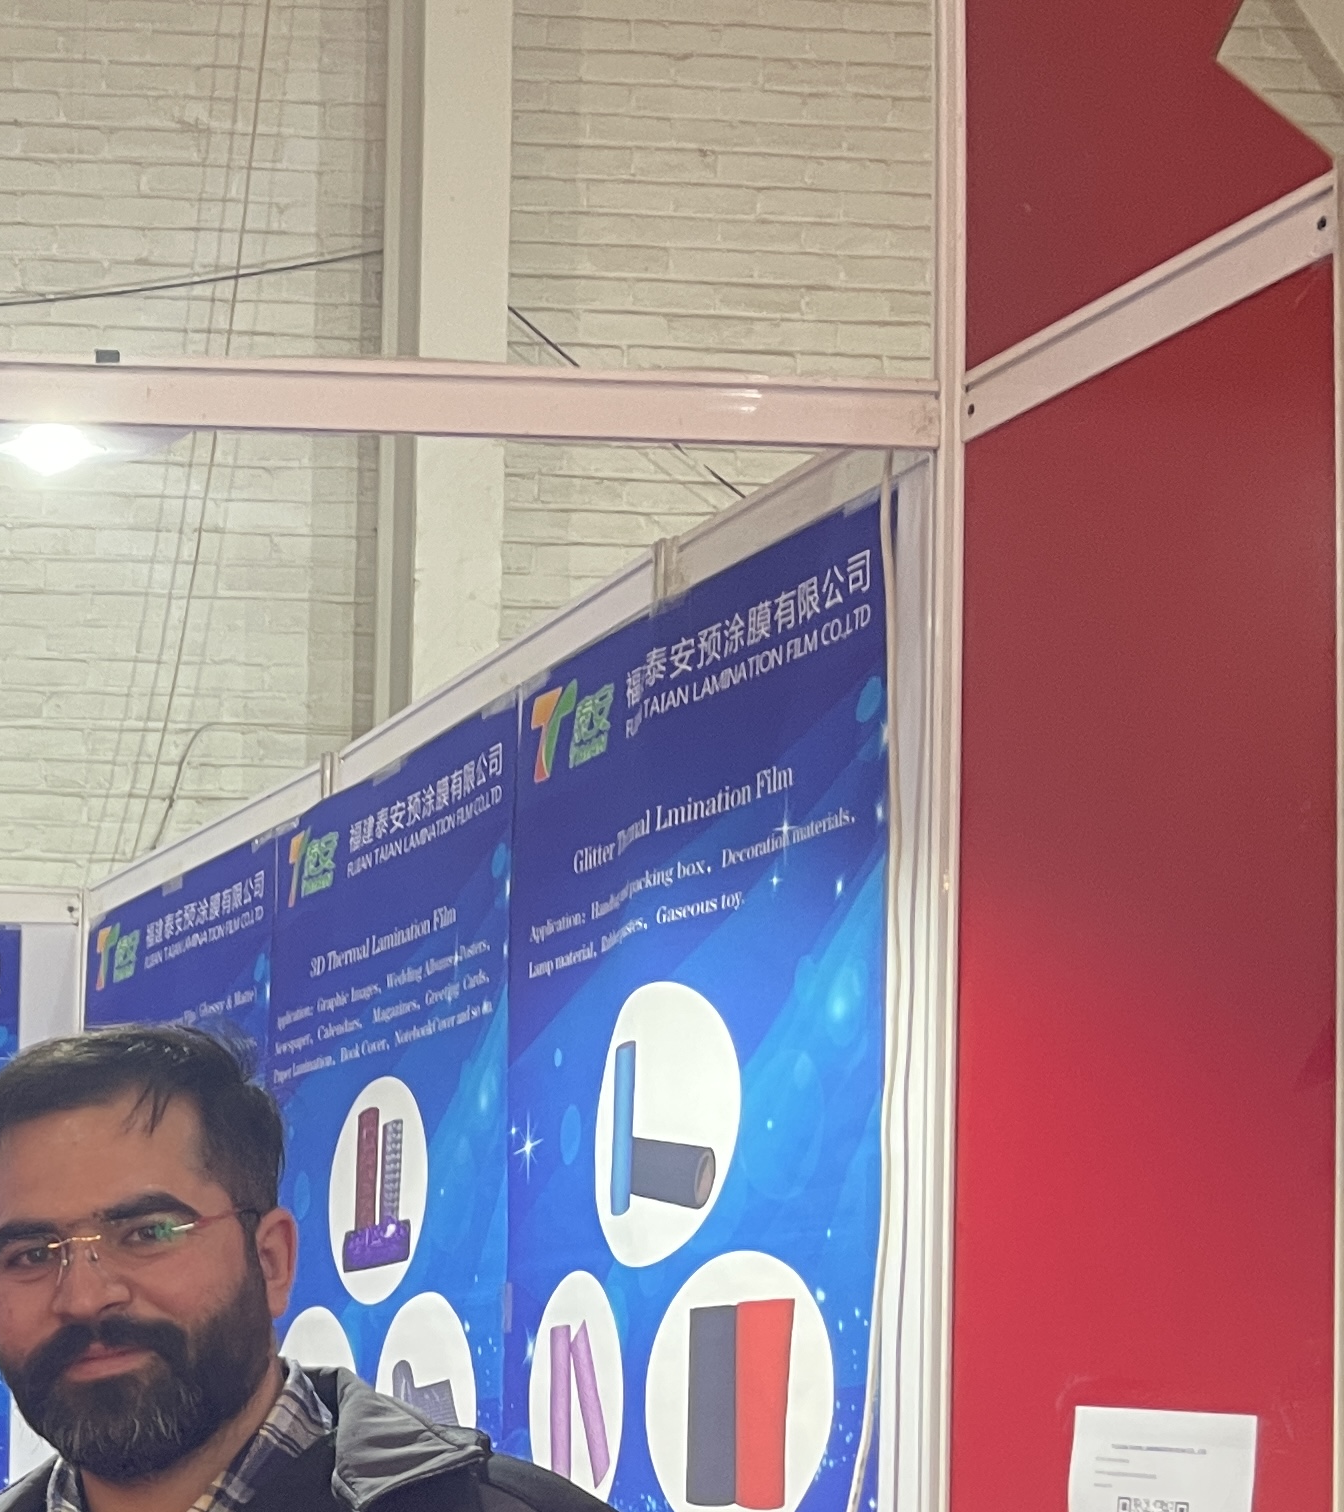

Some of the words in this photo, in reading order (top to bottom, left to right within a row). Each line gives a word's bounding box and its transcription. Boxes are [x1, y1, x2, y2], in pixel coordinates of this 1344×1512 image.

[626, 549, 870, 708] 福泰安预涂膜有限公司
[643, 685, 688, 718] TAIAN
[693, 644, 782, 701] LAMINATION
[786, 630, 817, 662] FILM
[573, 842, 616, 874] Glitter
[655, 785, 751, 832] Lmination
[756, 766, 793, 799] Film
[722, 834, 791, 868] Decoration
[328, 938, 370, 972] Thermal
[372, 919, 430, 956] Lamination
[433, 905, 456, 930] Film
[656, 898, 718, 925] Gaseous
